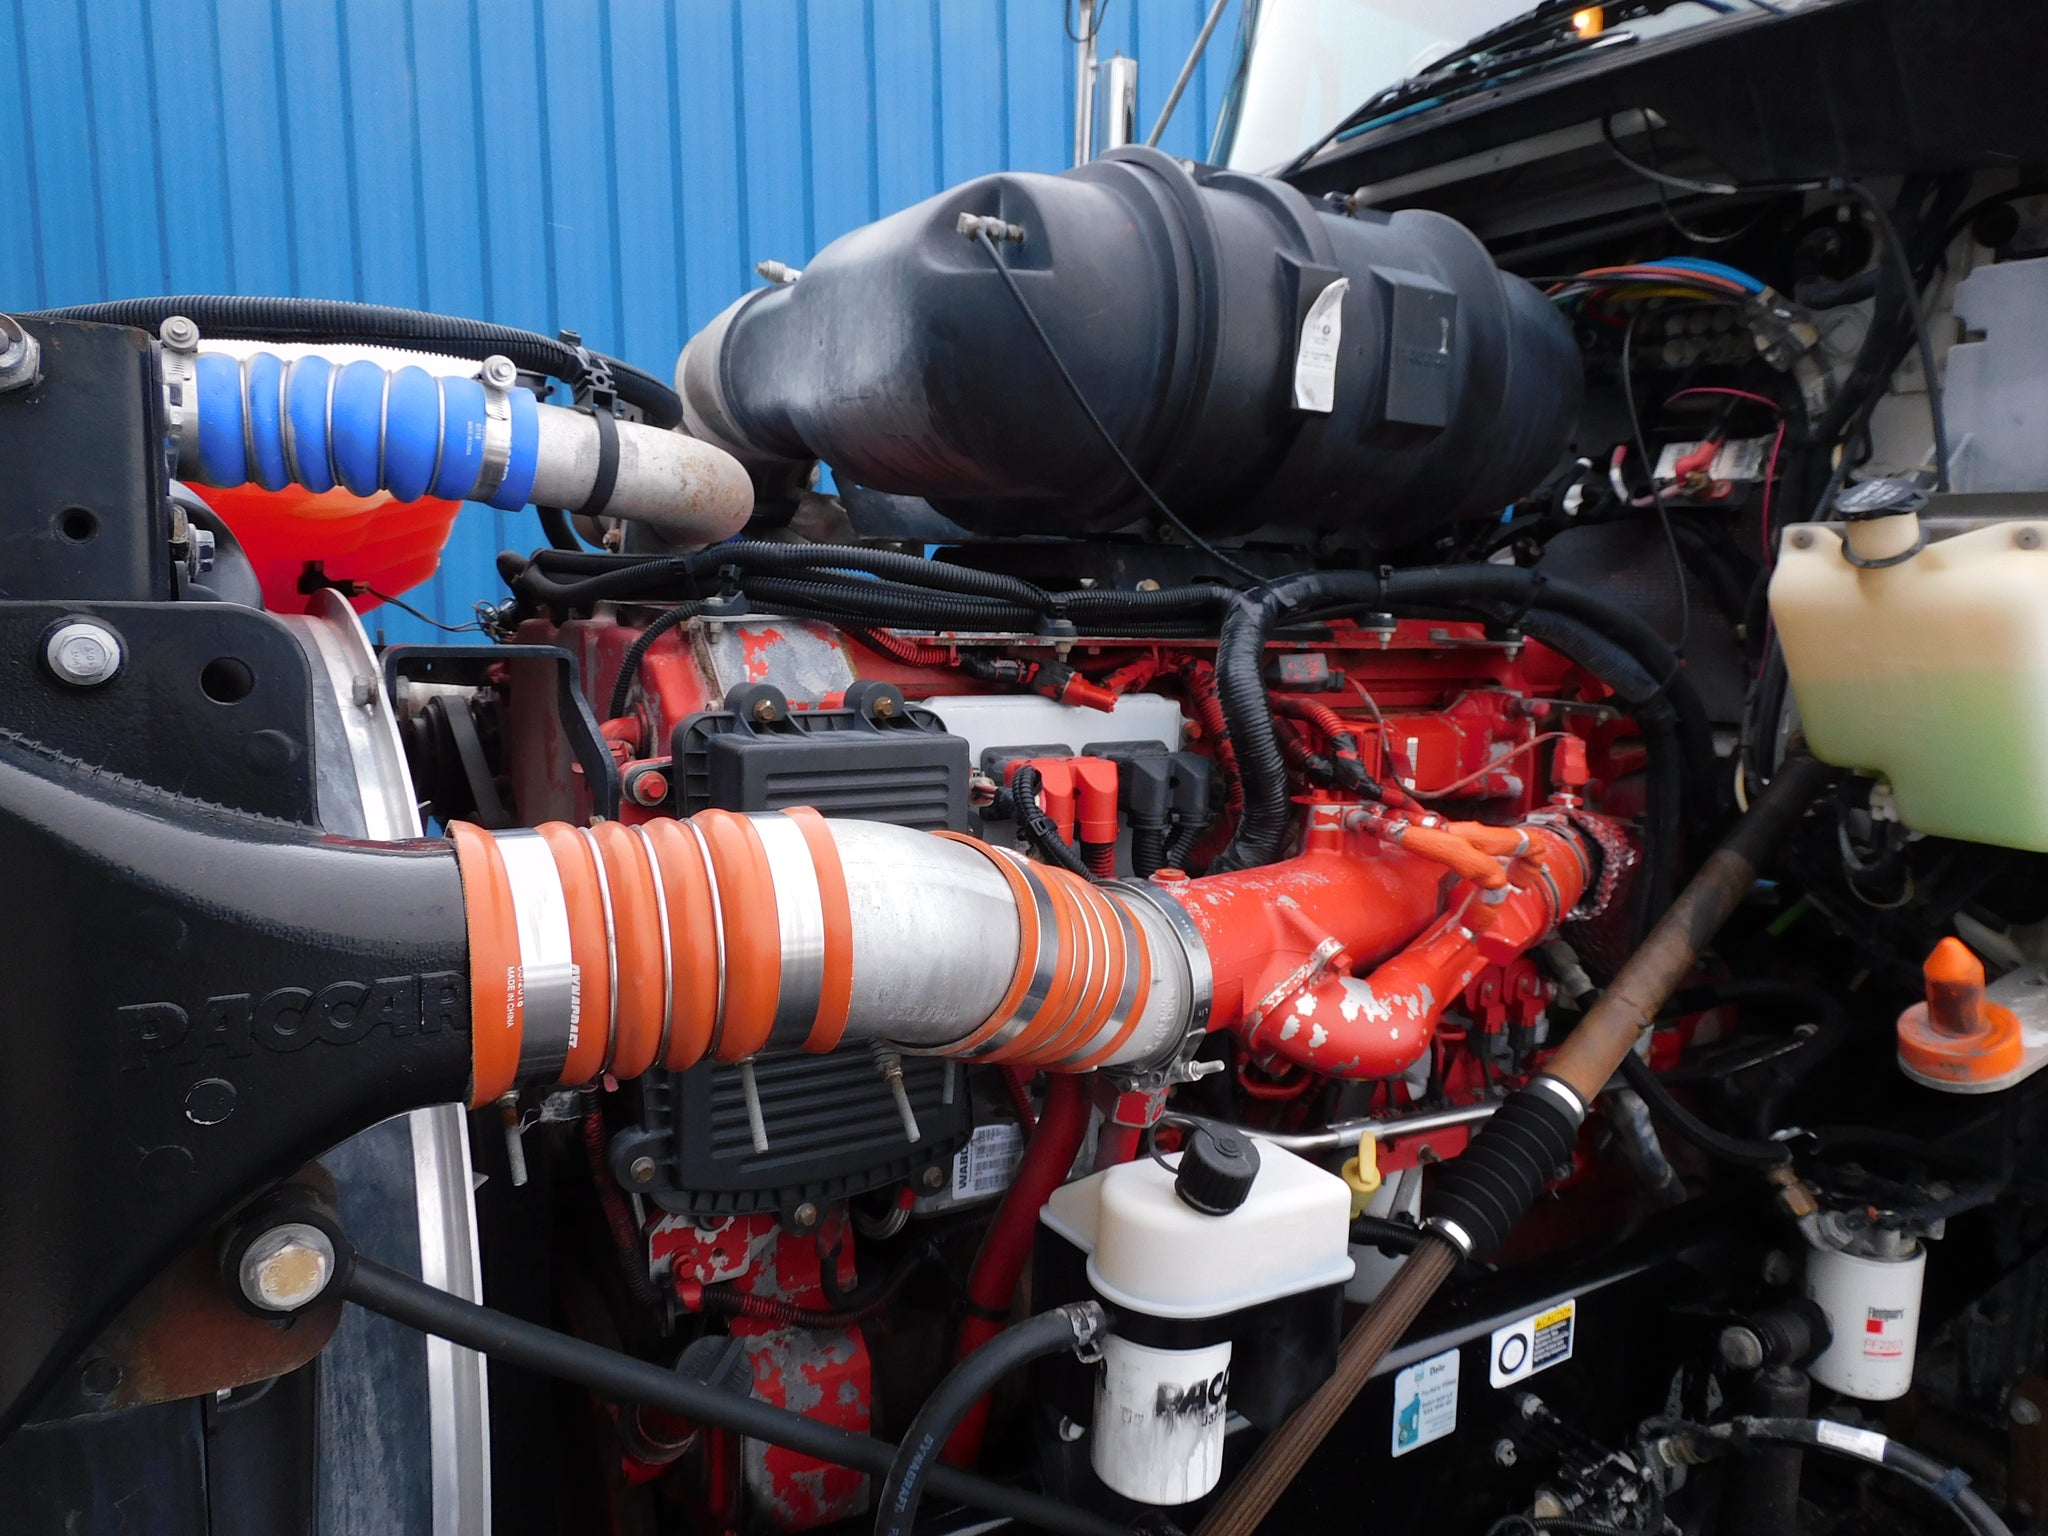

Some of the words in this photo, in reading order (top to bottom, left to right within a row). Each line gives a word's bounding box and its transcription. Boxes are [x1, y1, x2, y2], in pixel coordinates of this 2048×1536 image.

[506, 965, 516, 991] MADE
[506, 992, 515, 1002] IN
[117, 970, 468, 1073] PACCAR
[506, 1002, 515, 1029] CHINA
[958, 1145, 969, 1190] WABC
